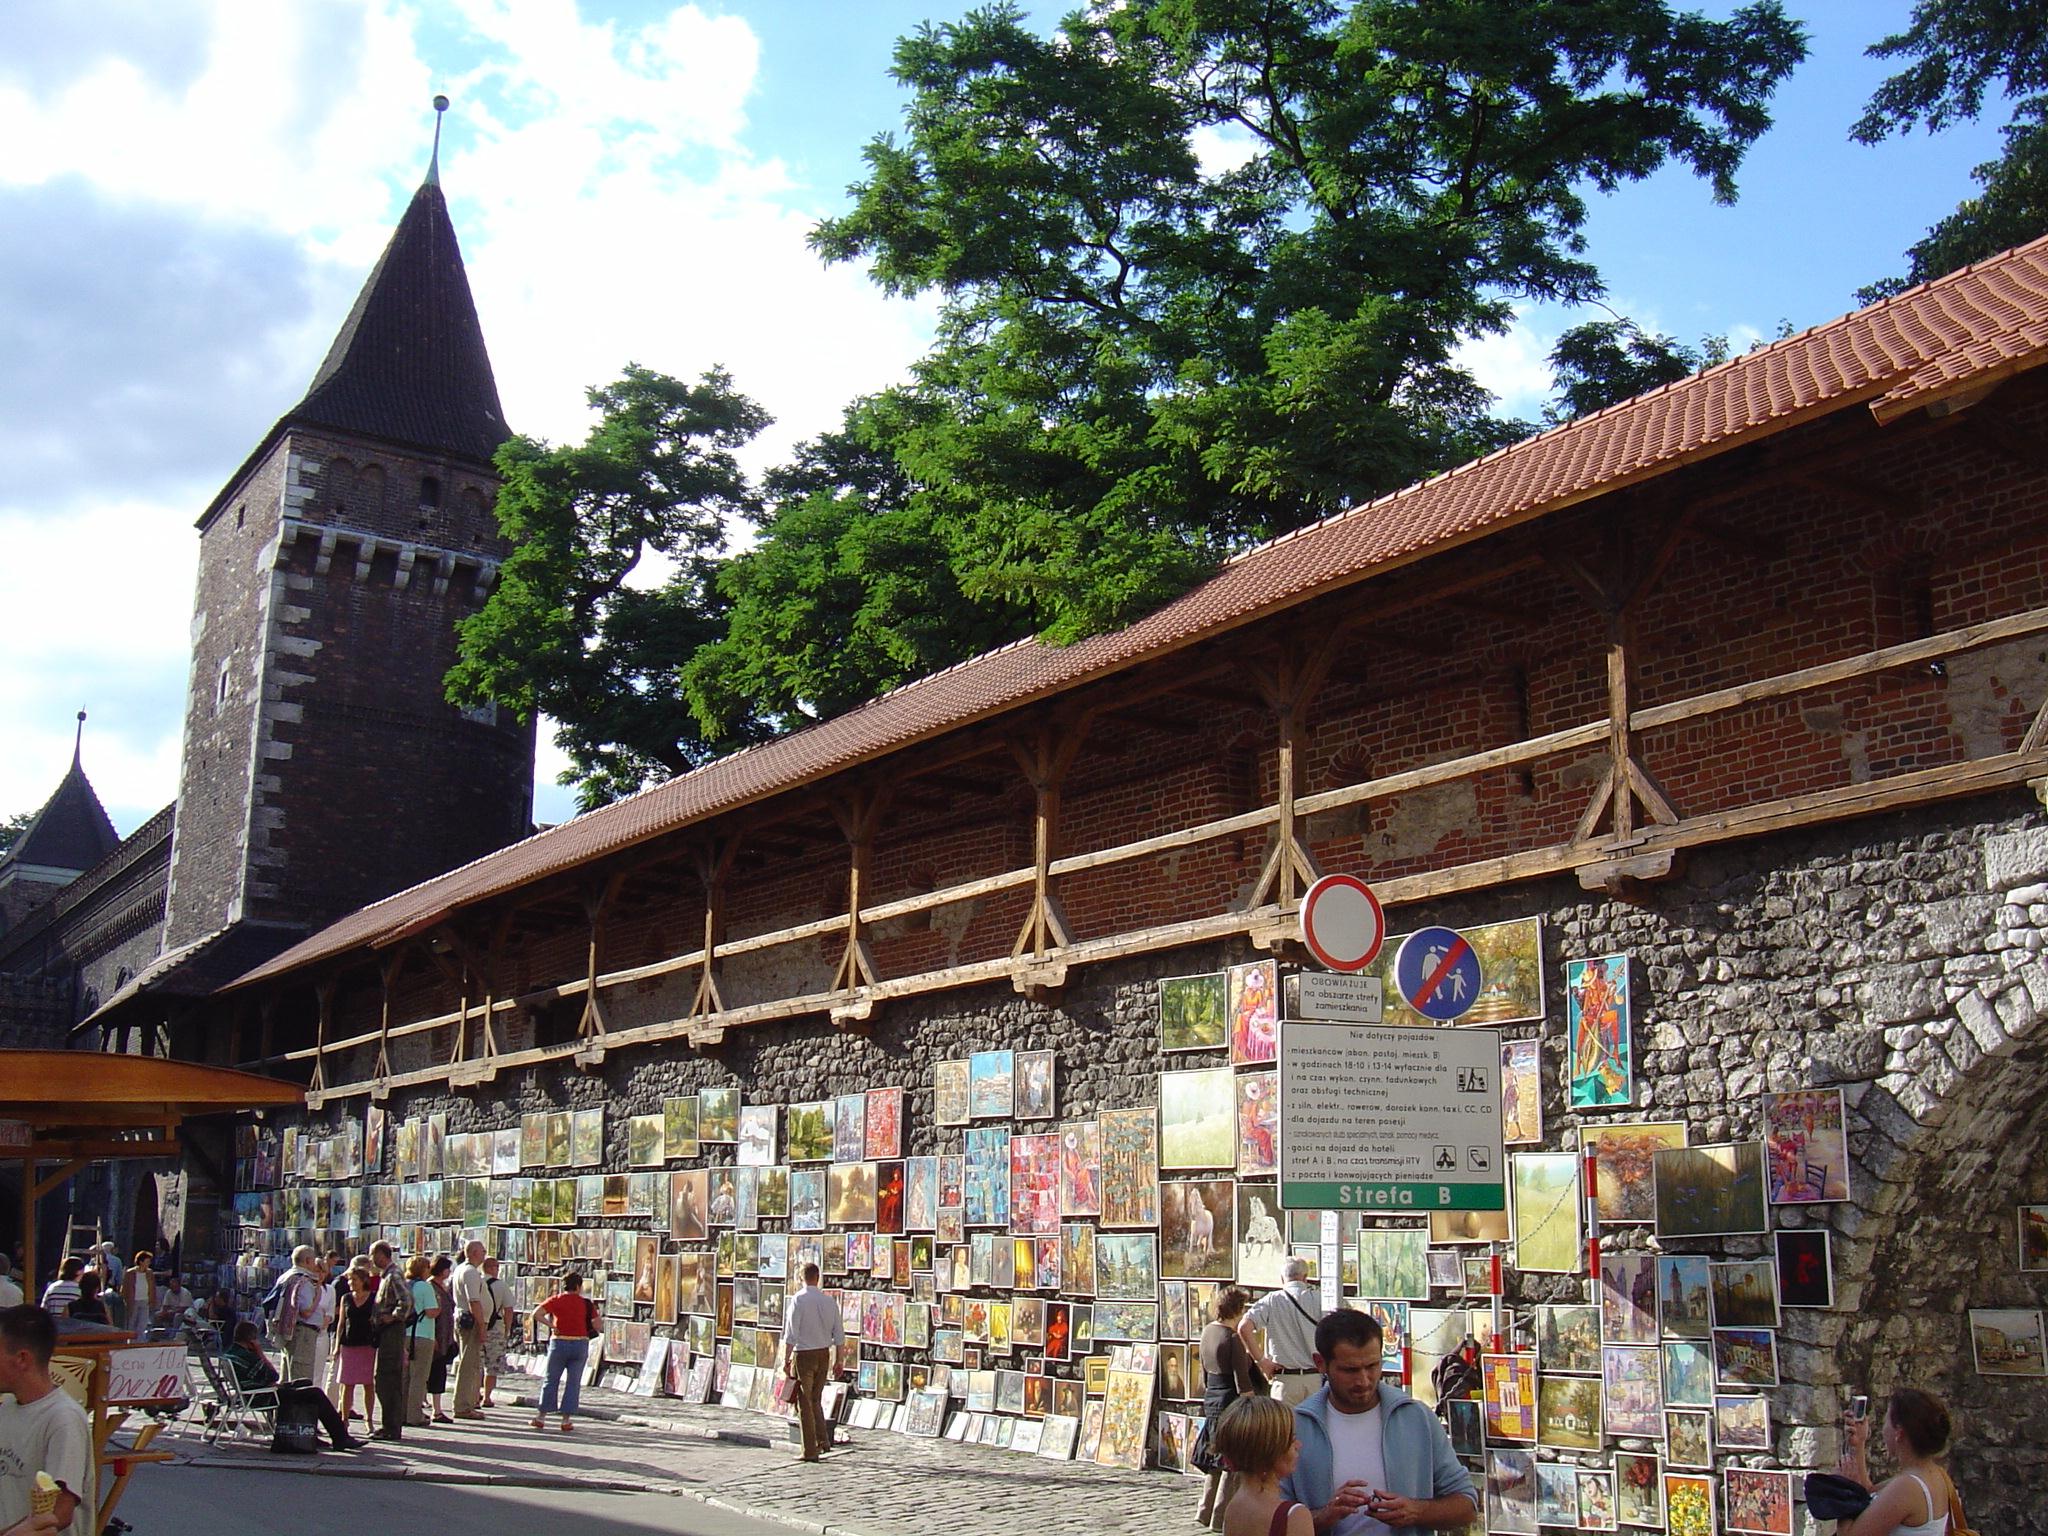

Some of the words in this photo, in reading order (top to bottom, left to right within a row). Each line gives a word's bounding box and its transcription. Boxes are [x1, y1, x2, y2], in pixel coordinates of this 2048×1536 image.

[1318, 989, 1353, 1000] obszarze
[1356, 992, 1379, 1005] strefy
[1315, 1001, 1368, 1013] zamieszkania
[1349, 1030, 1363, 1039] Nie
[1365, 1031, 1394, 1042] dotyczy
[1301, 1060, 1342, 1070] godzinach
[1344, 1060, 1365, 1070] 18-10
[1372, 1061, 1392, 1070] 13-14
[1434, 1064, 1448, 1072] dla
[1343, 1087, 1389, 1098] technicznej
[1480, 1104, 1493, 1114] CD
[1307, 1115, 1339, 1125] dojazdu
[1355, 1116, 1376, 1125] teren
[1378, 1116, 1406, 1127] posesji
[1315, 1144, 1326, 1152] na
[1328, 1143, 1356, 1154] dojazd
[1358, 1144, 1370, 1152] do
[1371, 1144, 1395, 1153] hoteli
[1292, 1156, 1310, 1165] stref
[1312, 1156, 1319, 1164] A
[1350, 1157, 1368, 1165] czas
[1405, 1156, 1421, 1165] RTV
[1339, 1184, 1413, 1205] Strefa
[1438, 1186, 1451, 1205] B
[109, 1374, 158, 1399] ONLY
[299, 1425, 315, 1436] Lee
